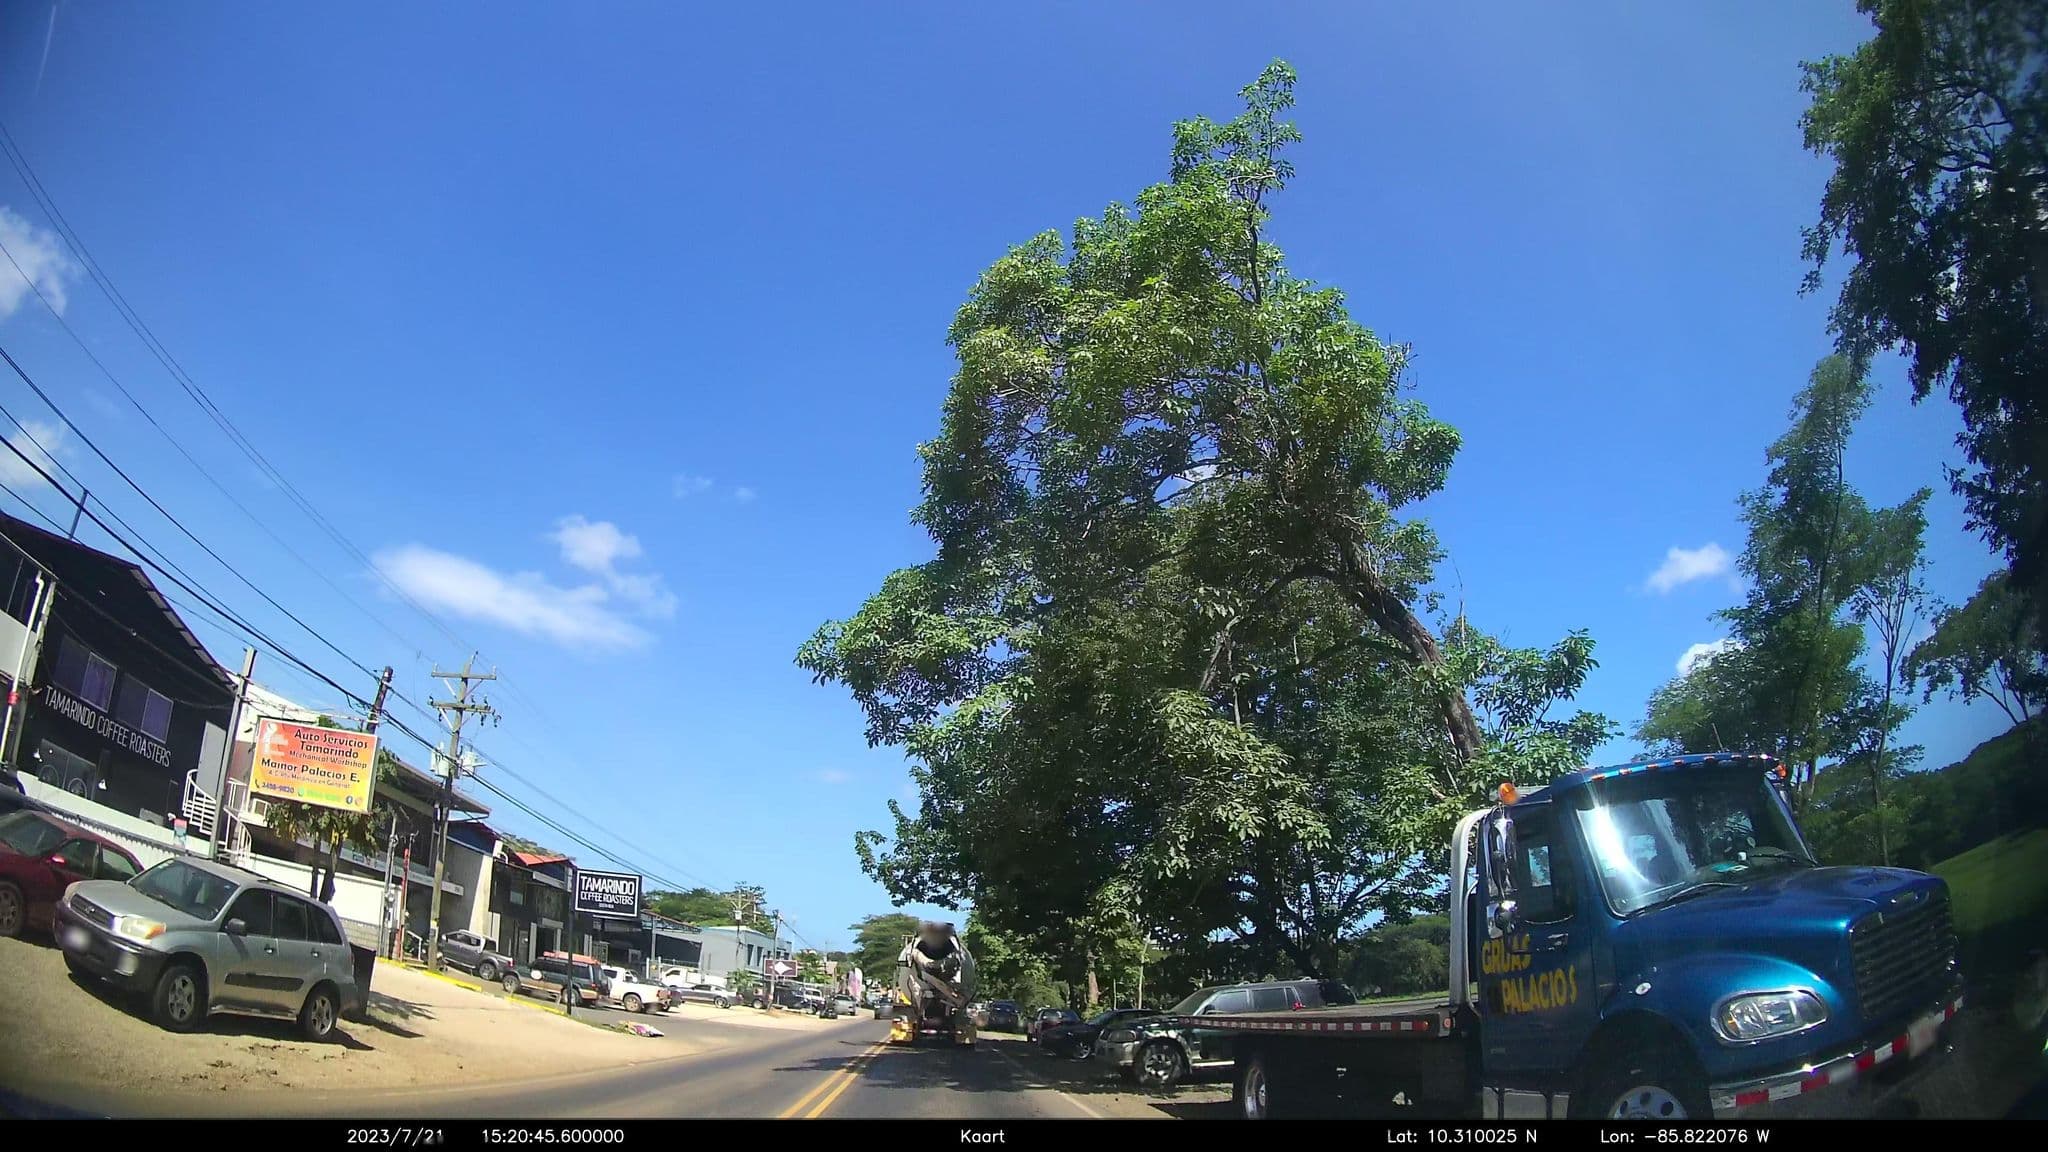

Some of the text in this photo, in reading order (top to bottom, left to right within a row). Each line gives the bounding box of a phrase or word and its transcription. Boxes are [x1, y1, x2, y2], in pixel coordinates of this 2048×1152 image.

[45, 685, 172, 768] TAMARINDO COFFEE ROASTERS
[295, 729, 368, 749] Auto Servicios
[289, 750, 329, 762] Mechanical
[300, 741, 359, 759] Tamarindo
[261, 758, 298, 772] Mainor
[301, 765, 346, 780] Palacios
[350, 772, 361, 783] E.
[580, 876, 634, 896] TAMARINDO
[580, 891, 603, 903] COFFEE
[603, 893, 634, 906] ROASTERS
[1481, 933, 1532, 975] GRUAS
[1501, 963, 1579, 1014] PALACIOS
